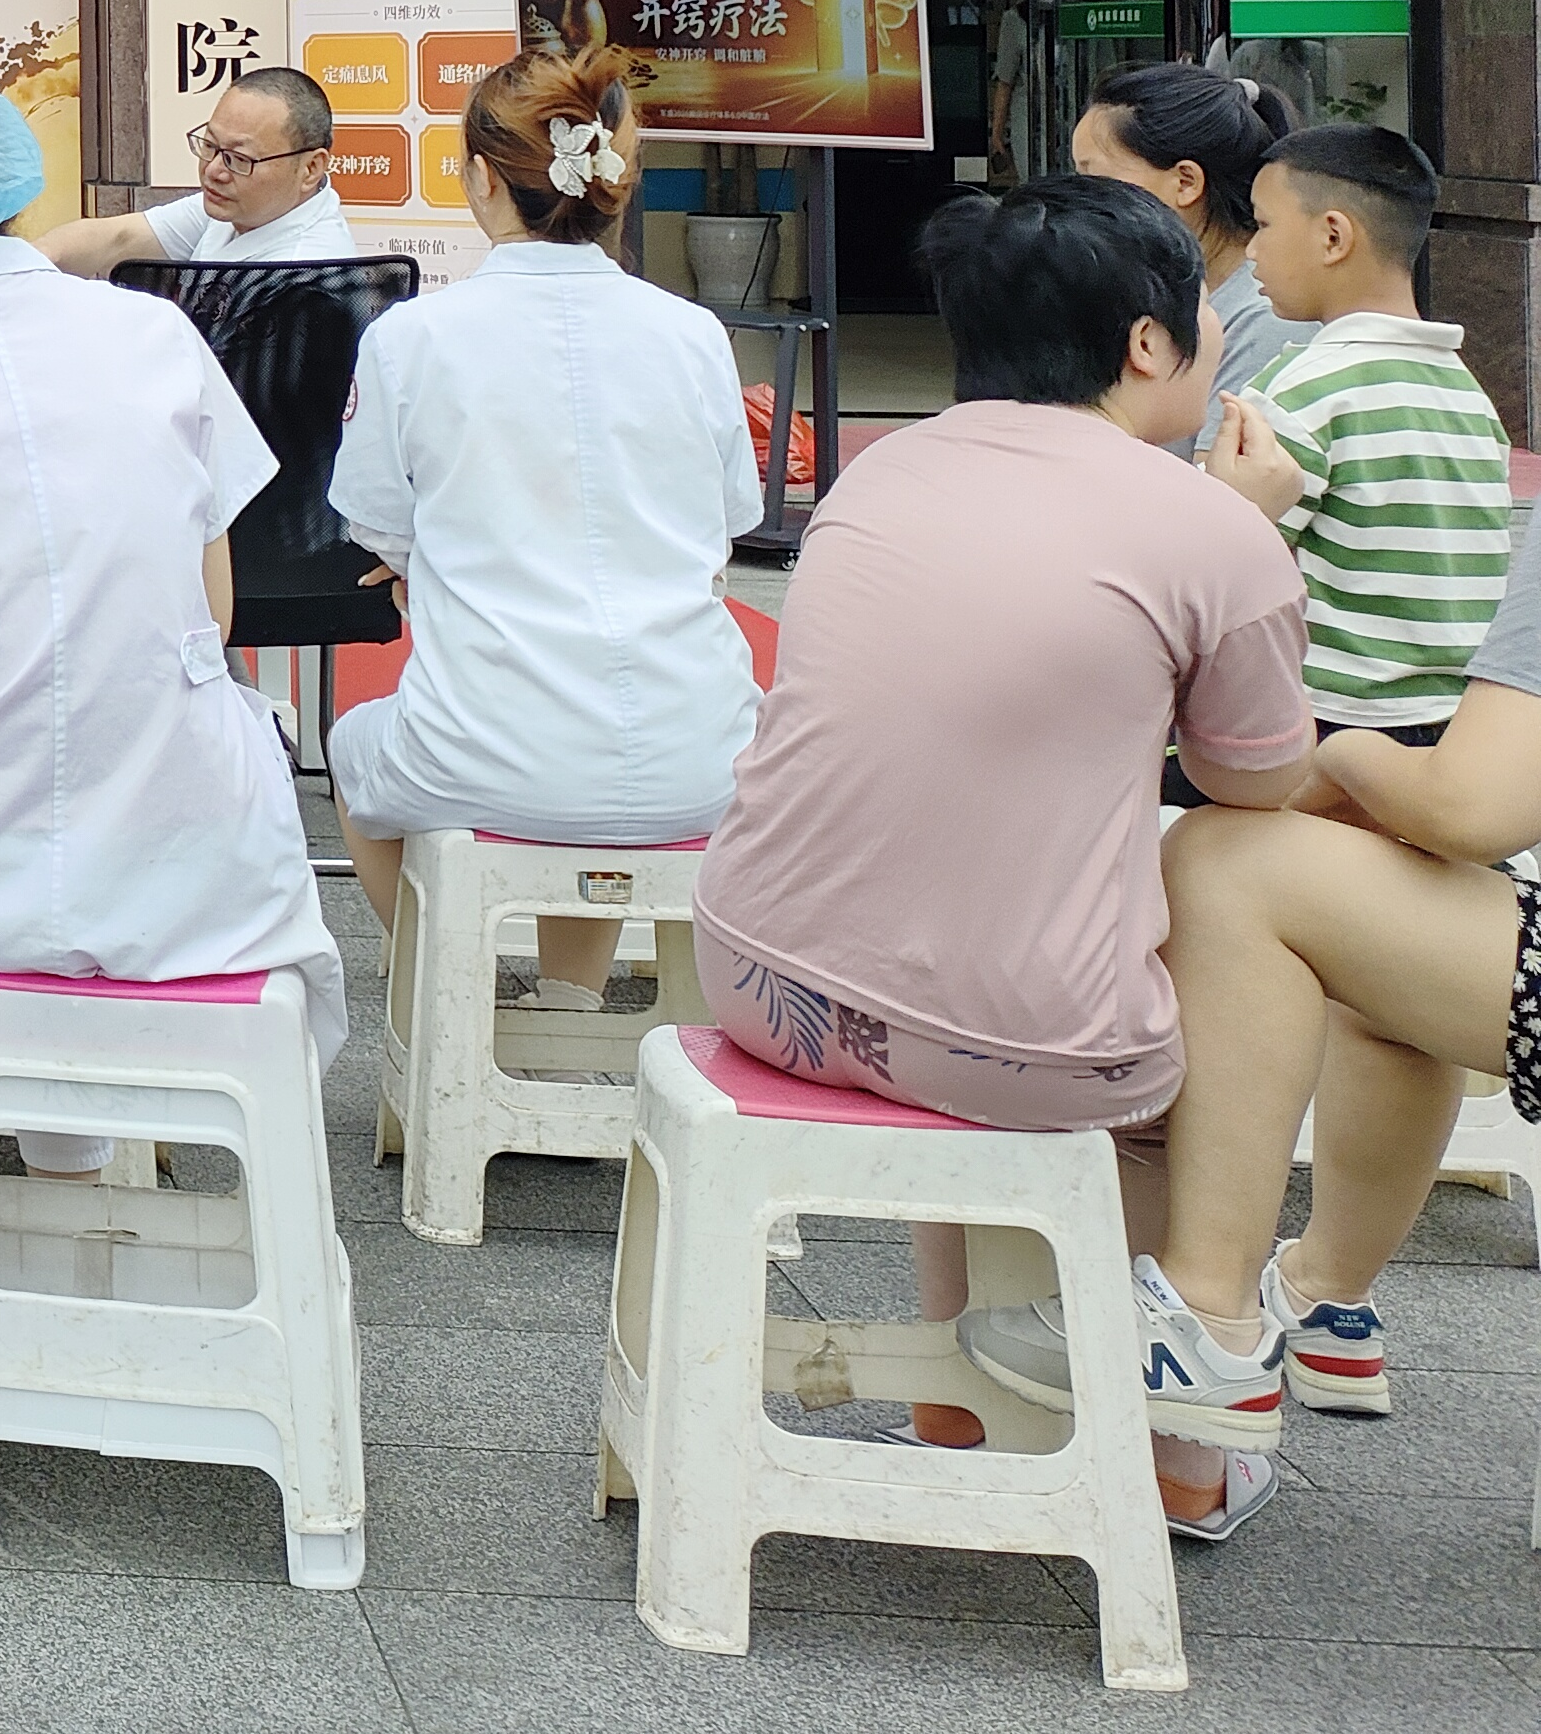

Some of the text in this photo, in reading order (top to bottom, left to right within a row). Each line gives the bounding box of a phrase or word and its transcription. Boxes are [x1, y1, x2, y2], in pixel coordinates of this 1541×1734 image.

[384, 5, 441, 20] 四维功效
[322, 65, 388, 84] 定痫息风
[438, 63, 499, 84] 通络化
[389, 238, 446, 255] 临床价值
[1150, 1280, 1169, 1301] NEW
